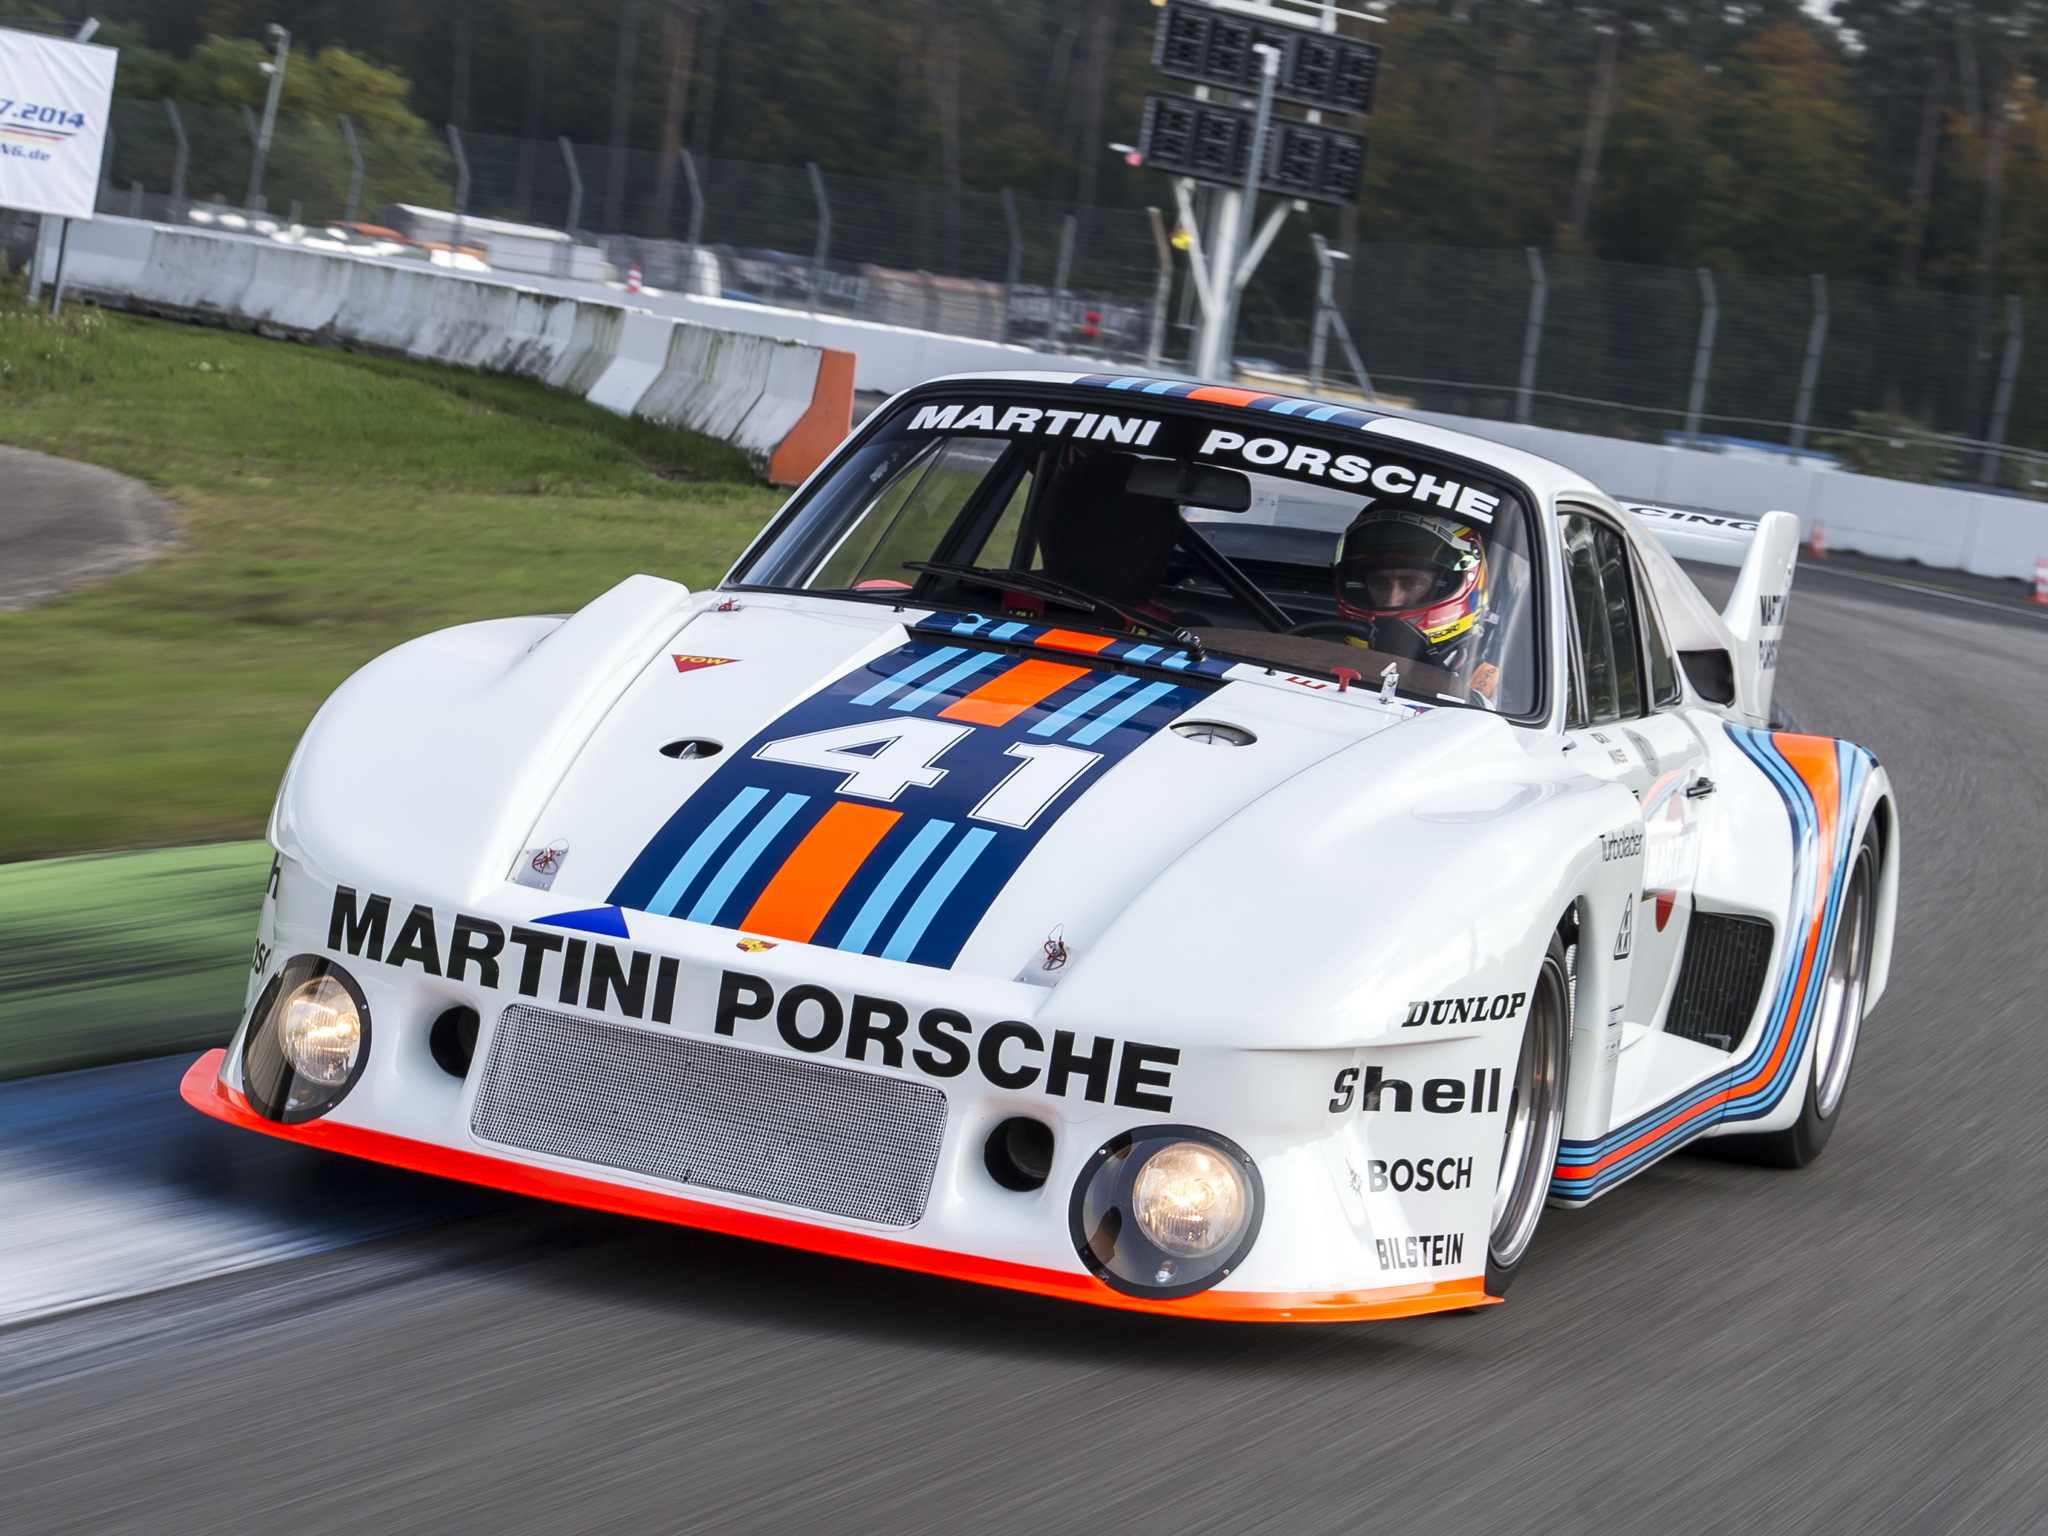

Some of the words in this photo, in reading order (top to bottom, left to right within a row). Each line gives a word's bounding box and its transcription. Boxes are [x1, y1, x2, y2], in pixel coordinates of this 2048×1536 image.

[907, 405, 1161, 446] MARTINI
[1200, 429, 1500, 524] PORSCHE
[680, 655, 728, 664] TOW
[752, 716, 1104, 830] 41
[1599, 829, 1643, 861] Turbolader
[327, 884, 680, 1025] MARTINI
[714, 978, 1180, 1113] PORSCHE
[1401, 992, 1526, 1027] DUNLOP
[1328, 1066, 1501, 1113] Shell
[1367, 1156, 1473, 1192] BOSCH
[1376, 1233, 1464, 1270] BILSTEIN
